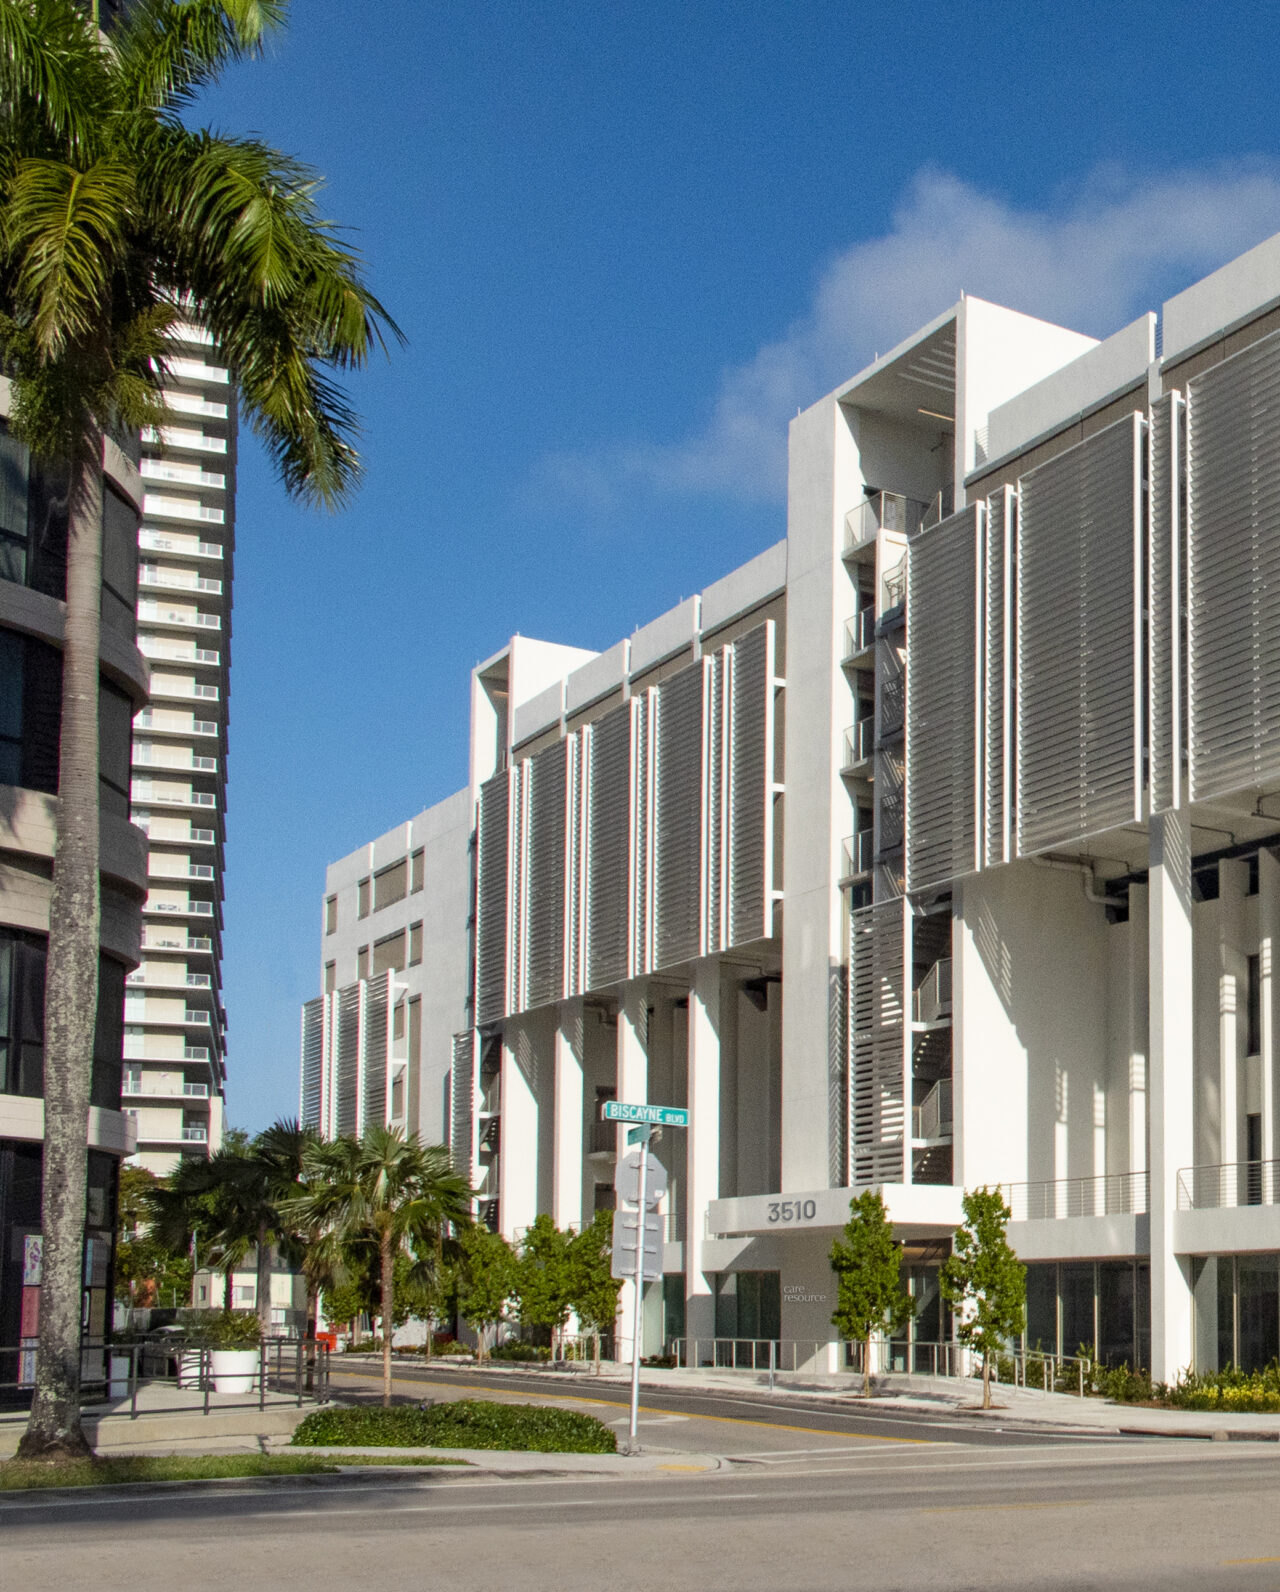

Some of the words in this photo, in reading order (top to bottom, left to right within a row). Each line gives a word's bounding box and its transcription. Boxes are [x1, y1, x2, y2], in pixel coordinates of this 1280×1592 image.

[610, 1104, 663, 1121] BISCAYNE
[665, 1113, 685, 1123] BLVD
[768, 1200, 816, 1222] 3510
[783, 1285, 805, 1294] care
[783, 1294, 826, 1302] resource
